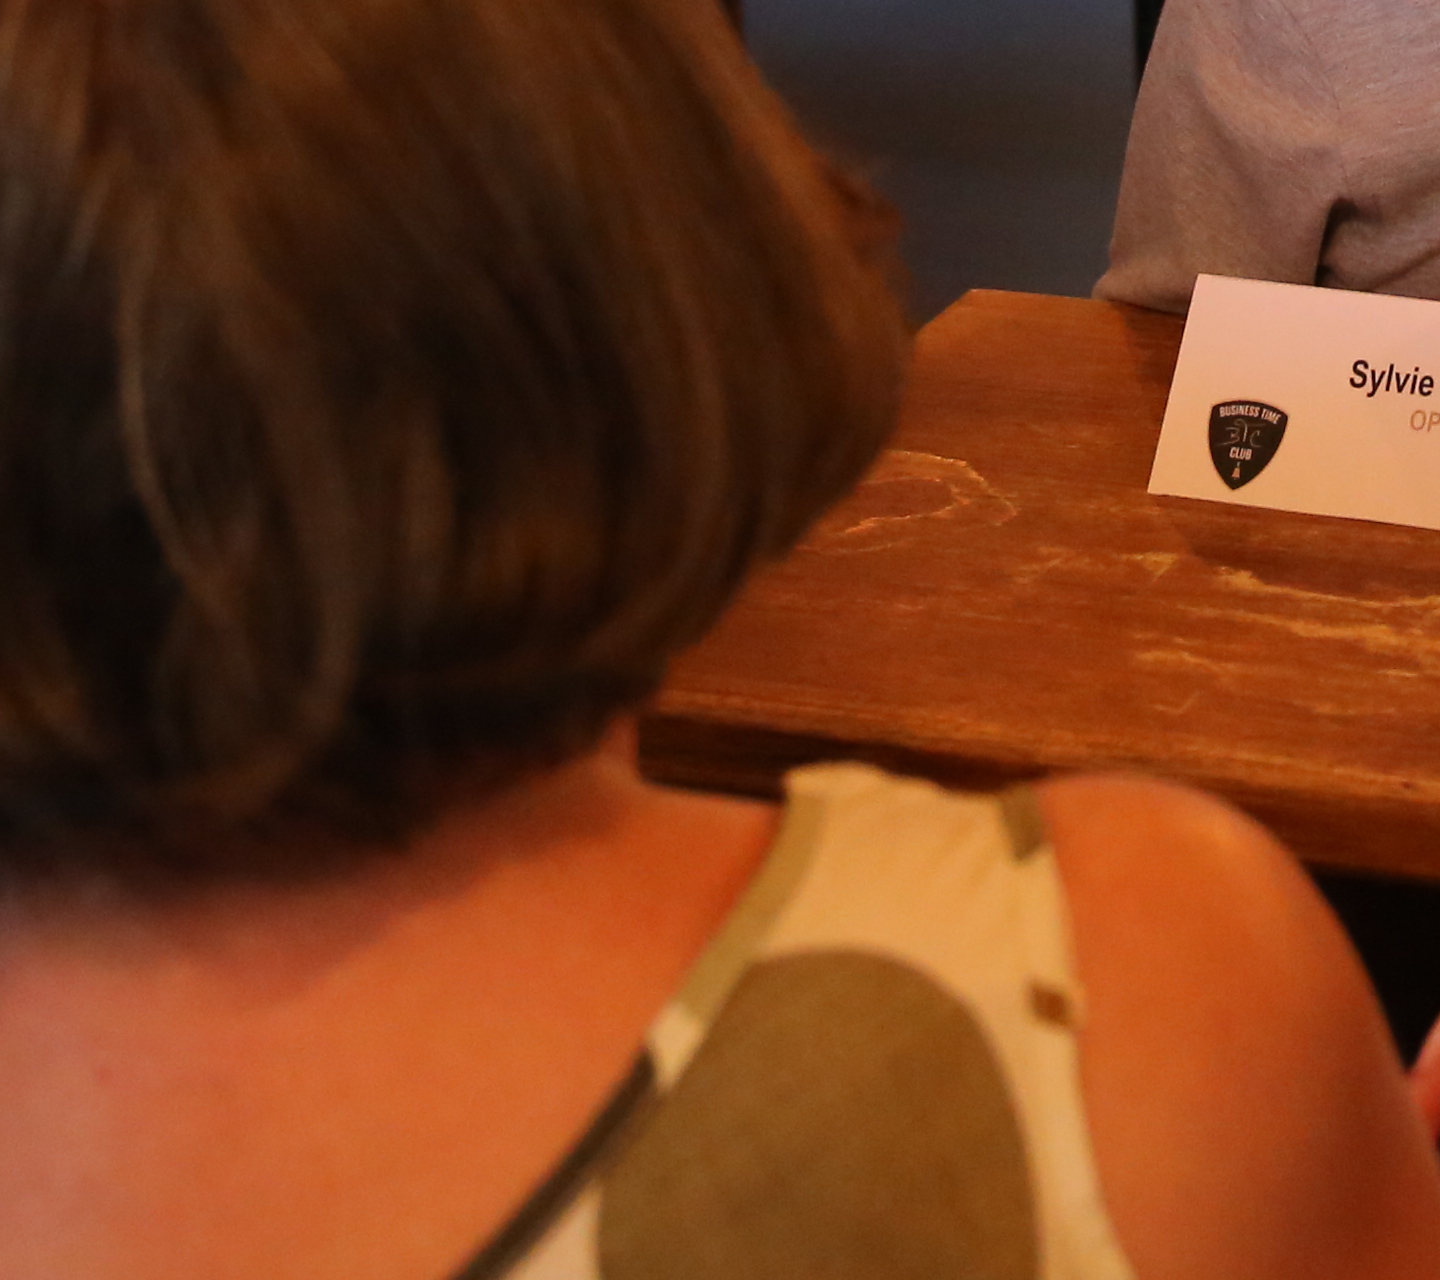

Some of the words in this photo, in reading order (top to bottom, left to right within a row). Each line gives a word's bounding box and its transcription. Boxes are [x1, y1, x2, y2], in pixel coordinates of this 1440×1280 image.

[1349, 359, 1435, 398] Sylvie
[1219, 405, 1260, 418] BUSINESS
[1261, 408, 1282, 425] TIME
[1229, 446, 1253, 461] CLUB
